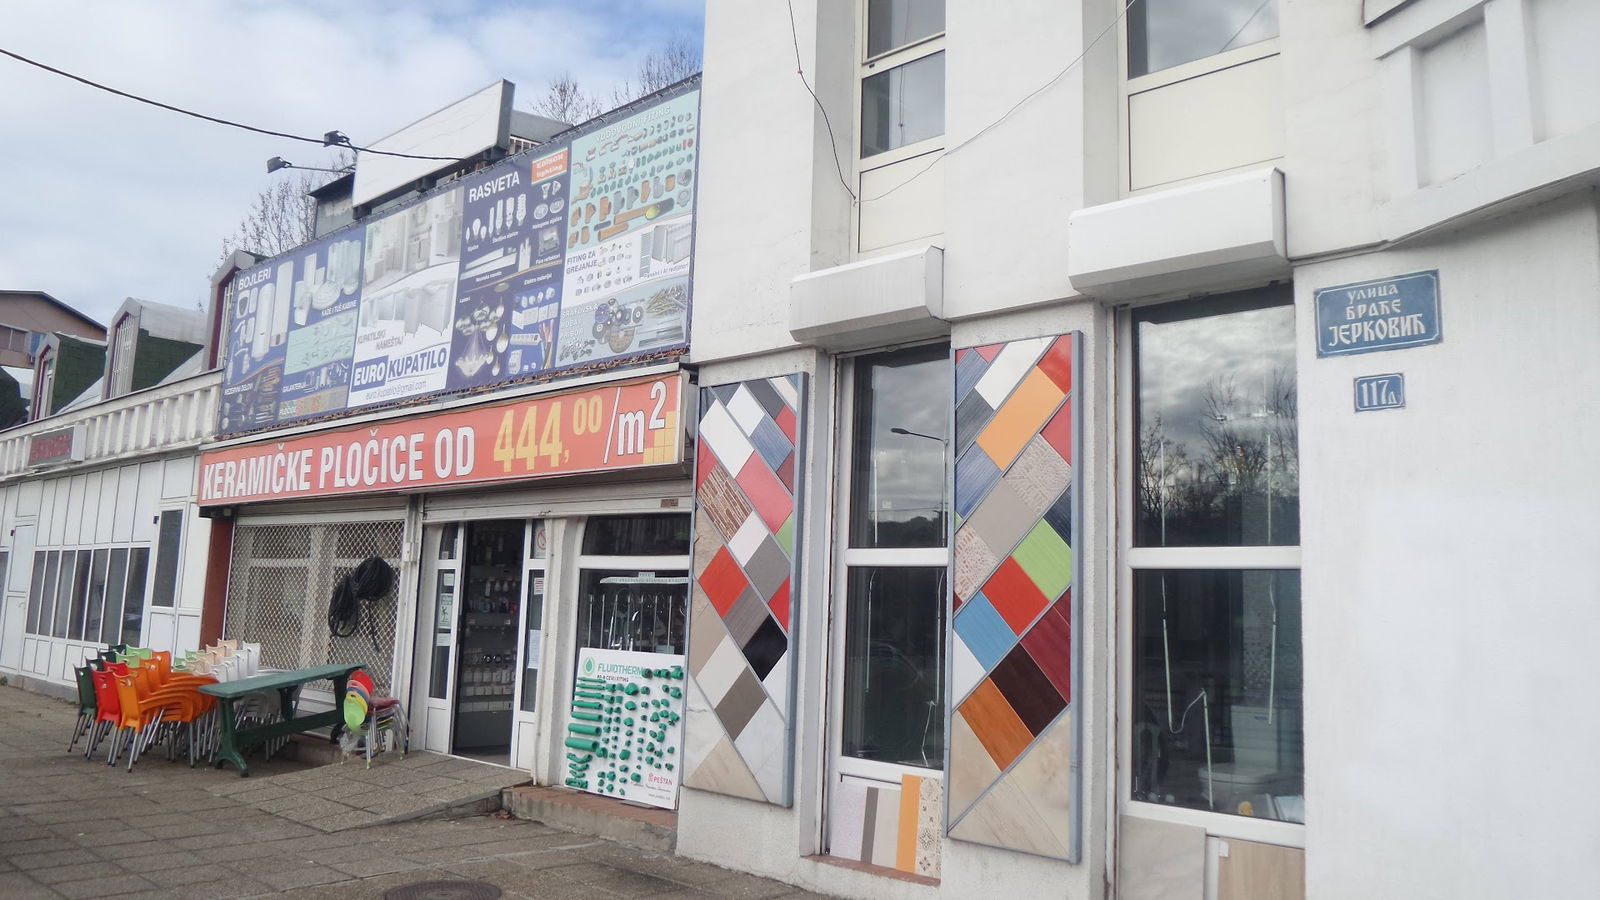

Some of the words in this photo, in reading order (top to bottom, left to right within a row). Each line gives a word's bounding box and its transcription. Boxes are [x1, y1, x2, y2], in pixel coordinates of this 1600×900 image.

[641, 106, 671, 124] FITING
[469, 171, 520, 203] RASVETA
[567, 251, 588, 264] FITING
[588, 249, 597, 259] ZA
[566, 260, 598, 275] GREJANJE
[238, 267, 272, 289] BOJLERI
[1346, 299, 1401, 320] БРАЋЕ
[357, 329, 386, 344] KUPATILSKI
[1328, 313, 1426, 347] ЈЕРКОВИЋ
[376, 335, 404, 351] NAMEŠTAJ
[354, 362, 386, 386] EURO
[388, 347, 447, 379] KUPATILO
[202, 442, 313, 500] KERAMIČKE
[319, 430, 425, 489] PLOČICE
[433, 426, 476, 474] OD
[654, 775, 673, 786] PEŠTAN
